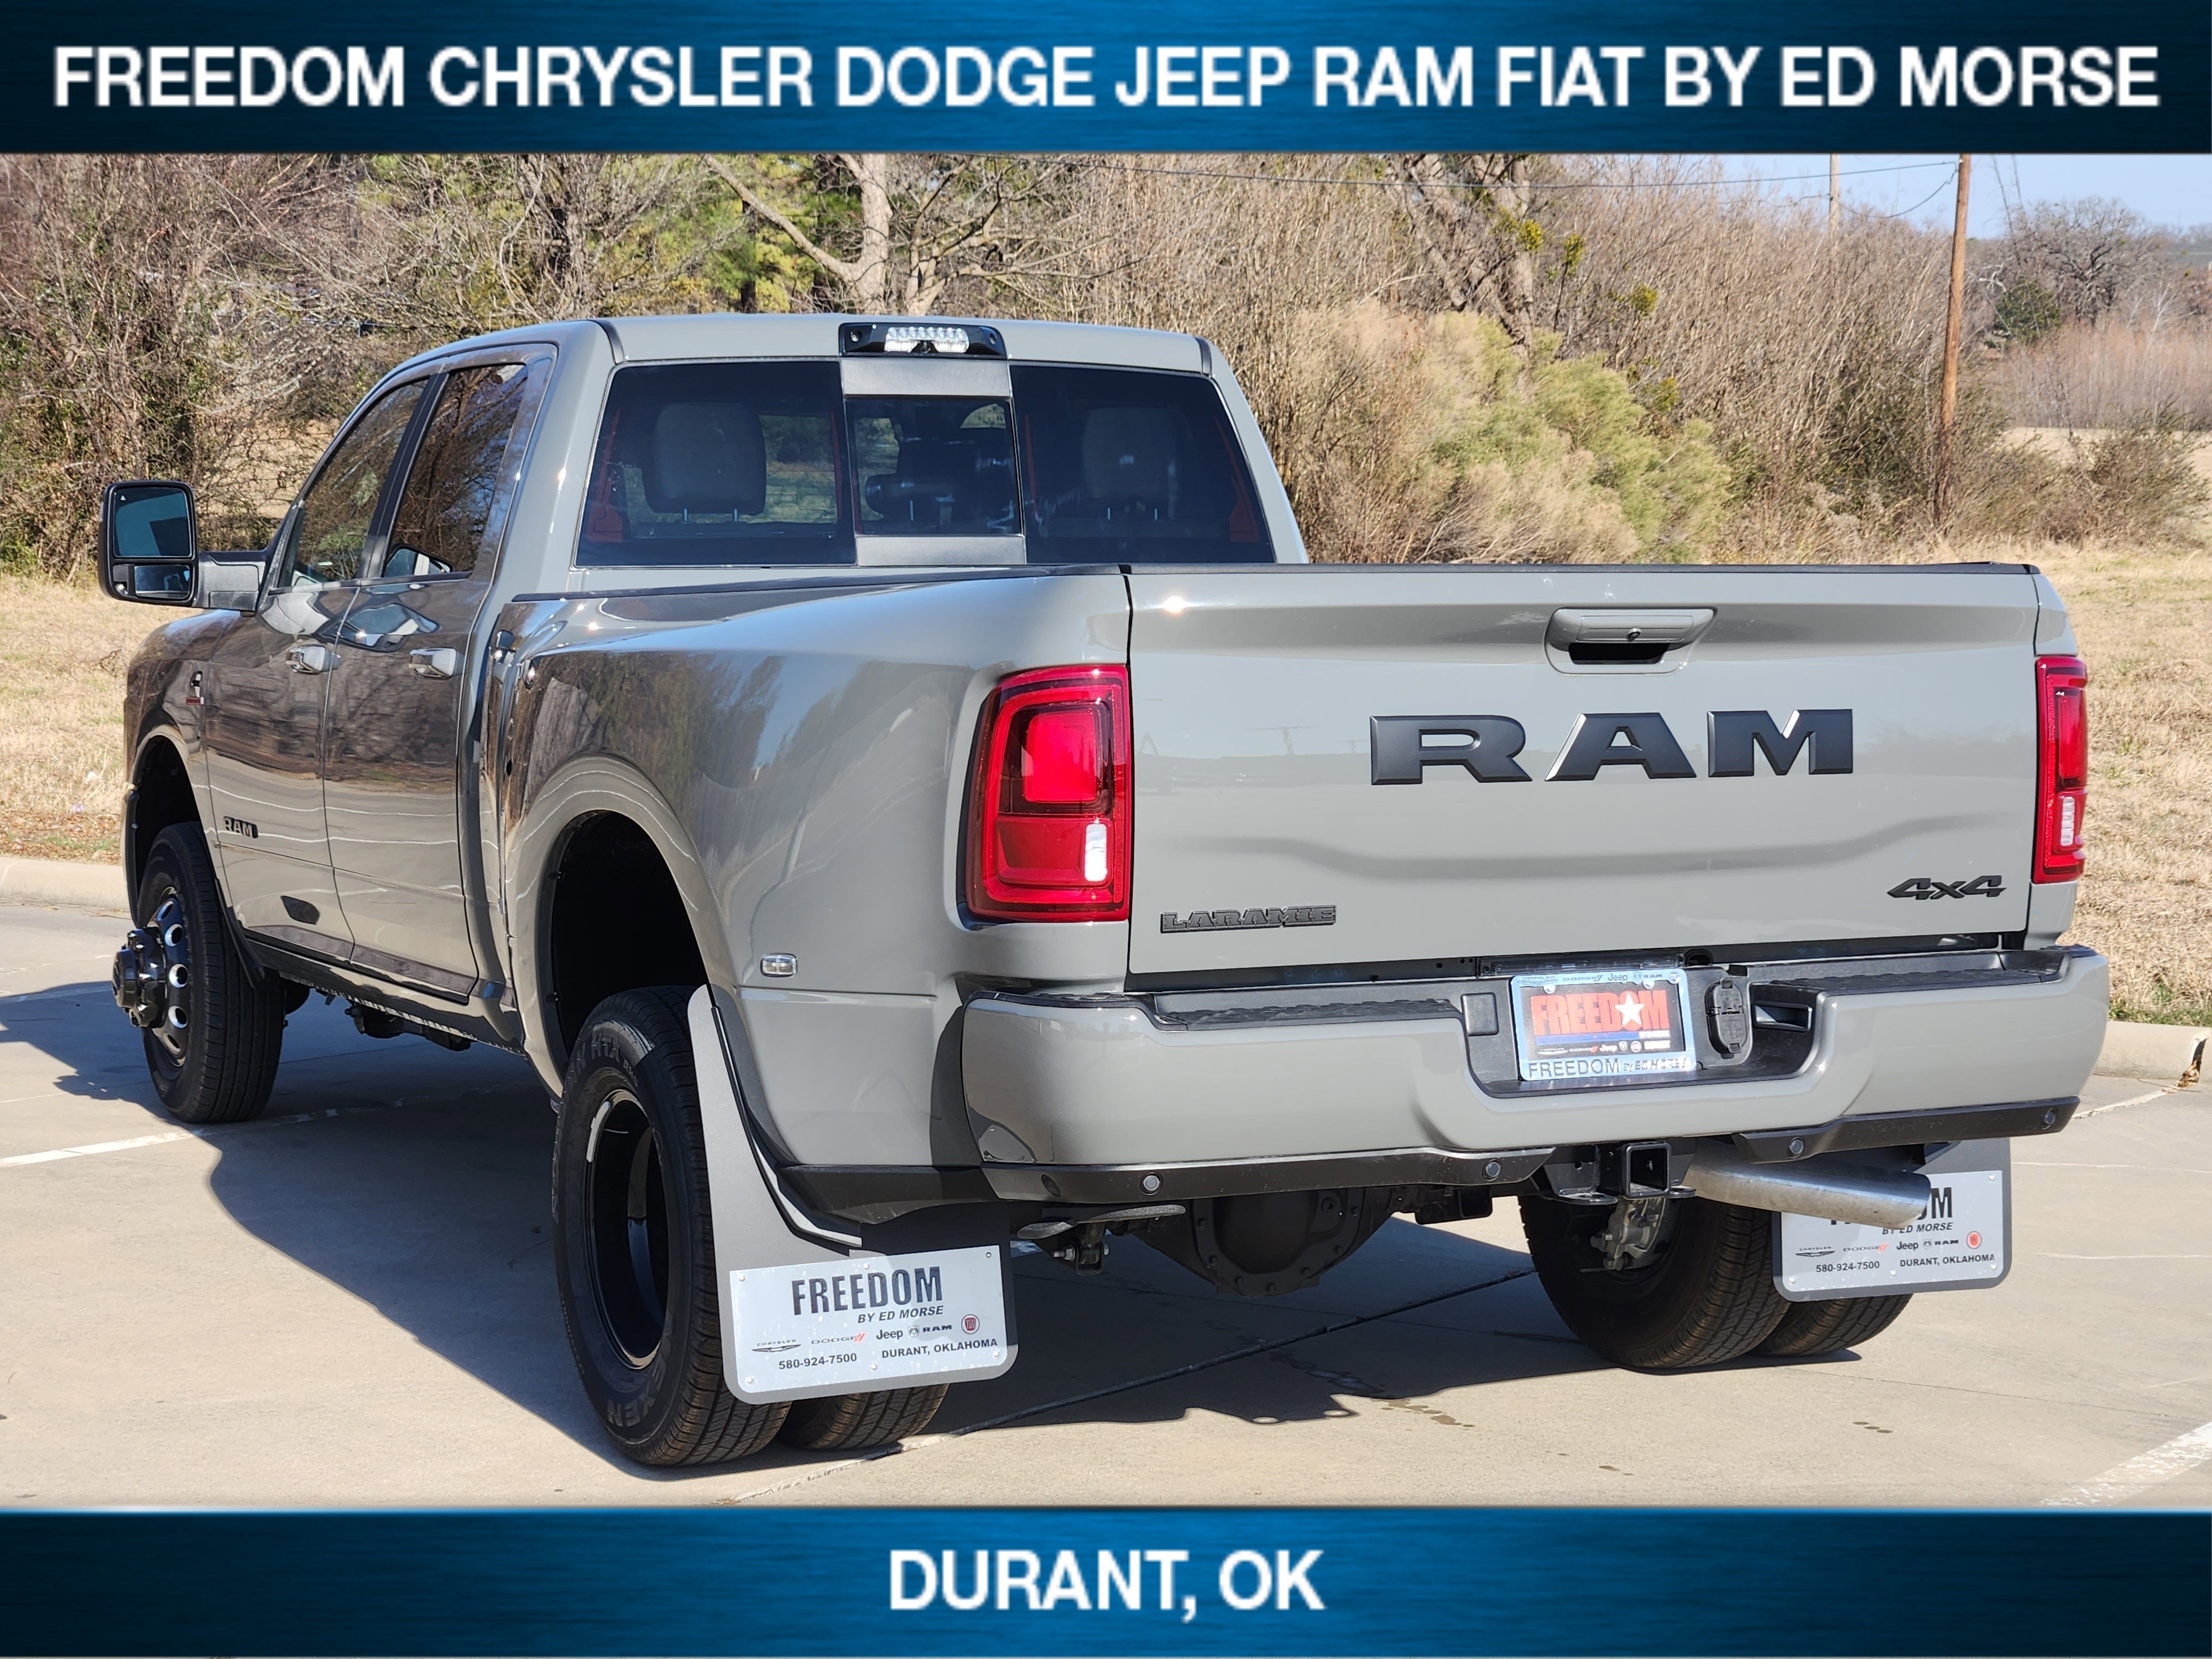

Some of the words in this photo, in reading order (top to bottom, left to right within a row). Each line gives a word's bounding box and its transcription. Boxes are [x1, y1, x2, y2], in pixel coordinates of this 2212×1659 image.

[1370, 709, 1854, 785] RAM
[223, 816, 258, 838] RAM
[1887, 875, 2007, 900] 4x4
[1160, 905, 1337, 933] LARAMIE
[1608, 973, 1627, 982] Jeep
[1530, 990, 1670, 1035] FREEDOM
[1528, 1058, 1620, 1078] FREEDOM
[1916, 1222, 1953, 1233] MORSE
[1896, 1241, 1918, 1251] Jeep
[1816, 1261, 1880, 1272] 580-924-7500
[1900, 1257, 1939, 1267] DURANT,
[1943, 1254, 1995, 1264] OKLAHOMA
[792, 1266, 942, 1315] FREEDOM
[858, 1312, 875, 1323] BY
[879, 1311, 895, 1321] ED
[899, 1306, 944, 1319] MORSE
[876, 1329, 904, 1340] Jeep
[881, 1345, 930, 1358] DURANT,
[933, 1338, 998, 1353] OKLAHOMA
[779, 1353, 857, 1370] 580-924-7500
